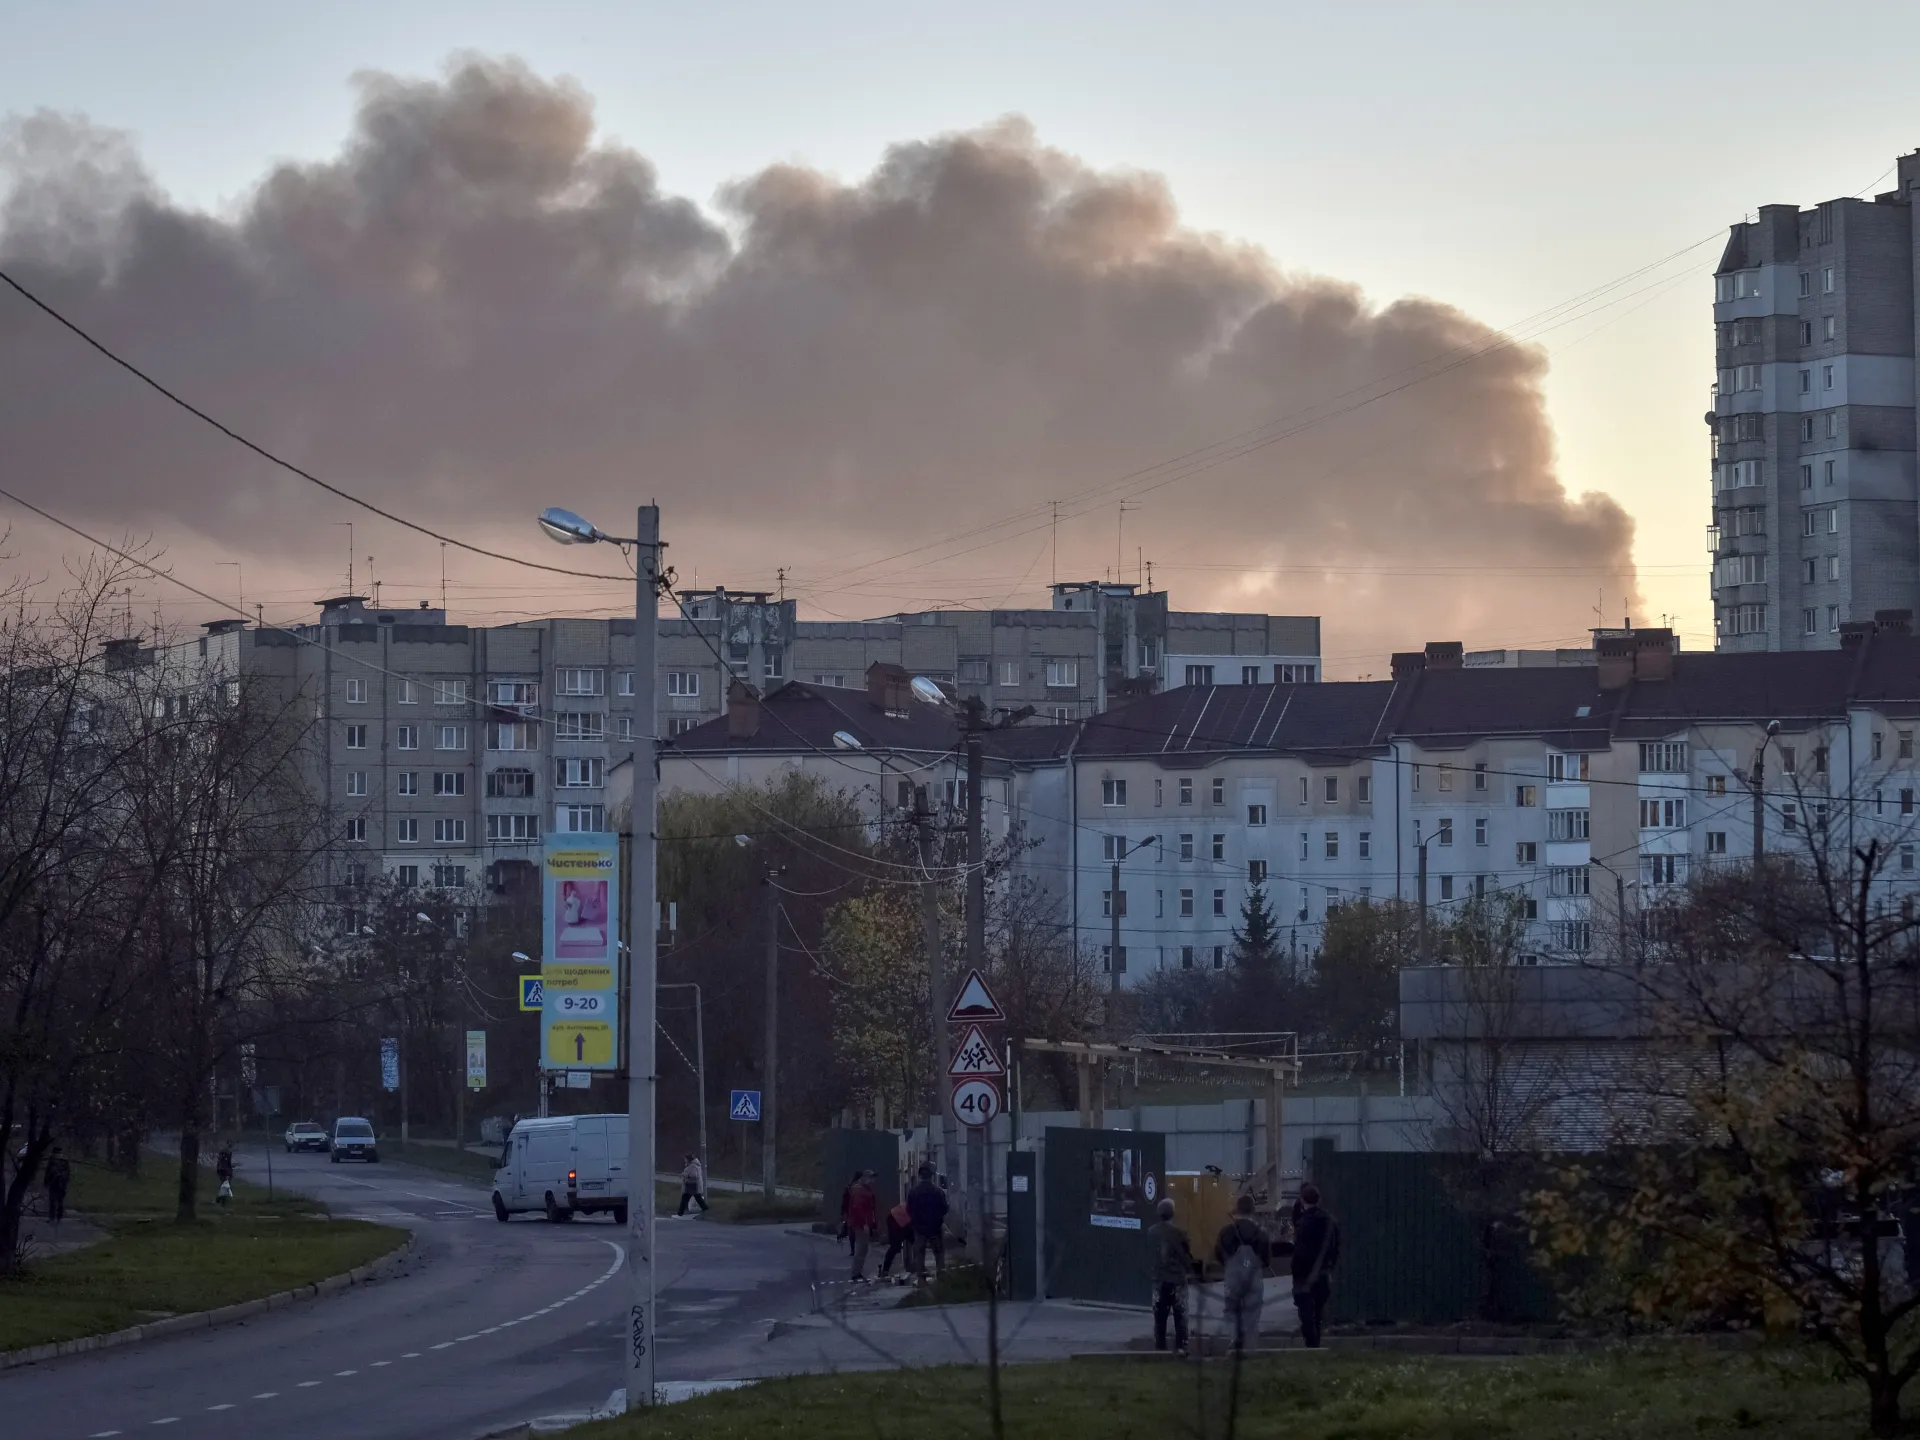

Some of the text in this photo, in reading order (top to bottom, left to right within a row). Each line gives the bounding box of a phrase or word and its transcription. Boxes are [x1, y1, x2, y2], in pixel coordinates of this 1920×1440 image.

[547, 858, 613, 868] Чистенько
[563, 968, 610, 976] щоденних
[546, 978, 579, 987] потреб
[564, 997, 598, 1010] 9-20
[960, 1093, 991, 1113] 40
[1148, 1182, 1153, 1194] 5
